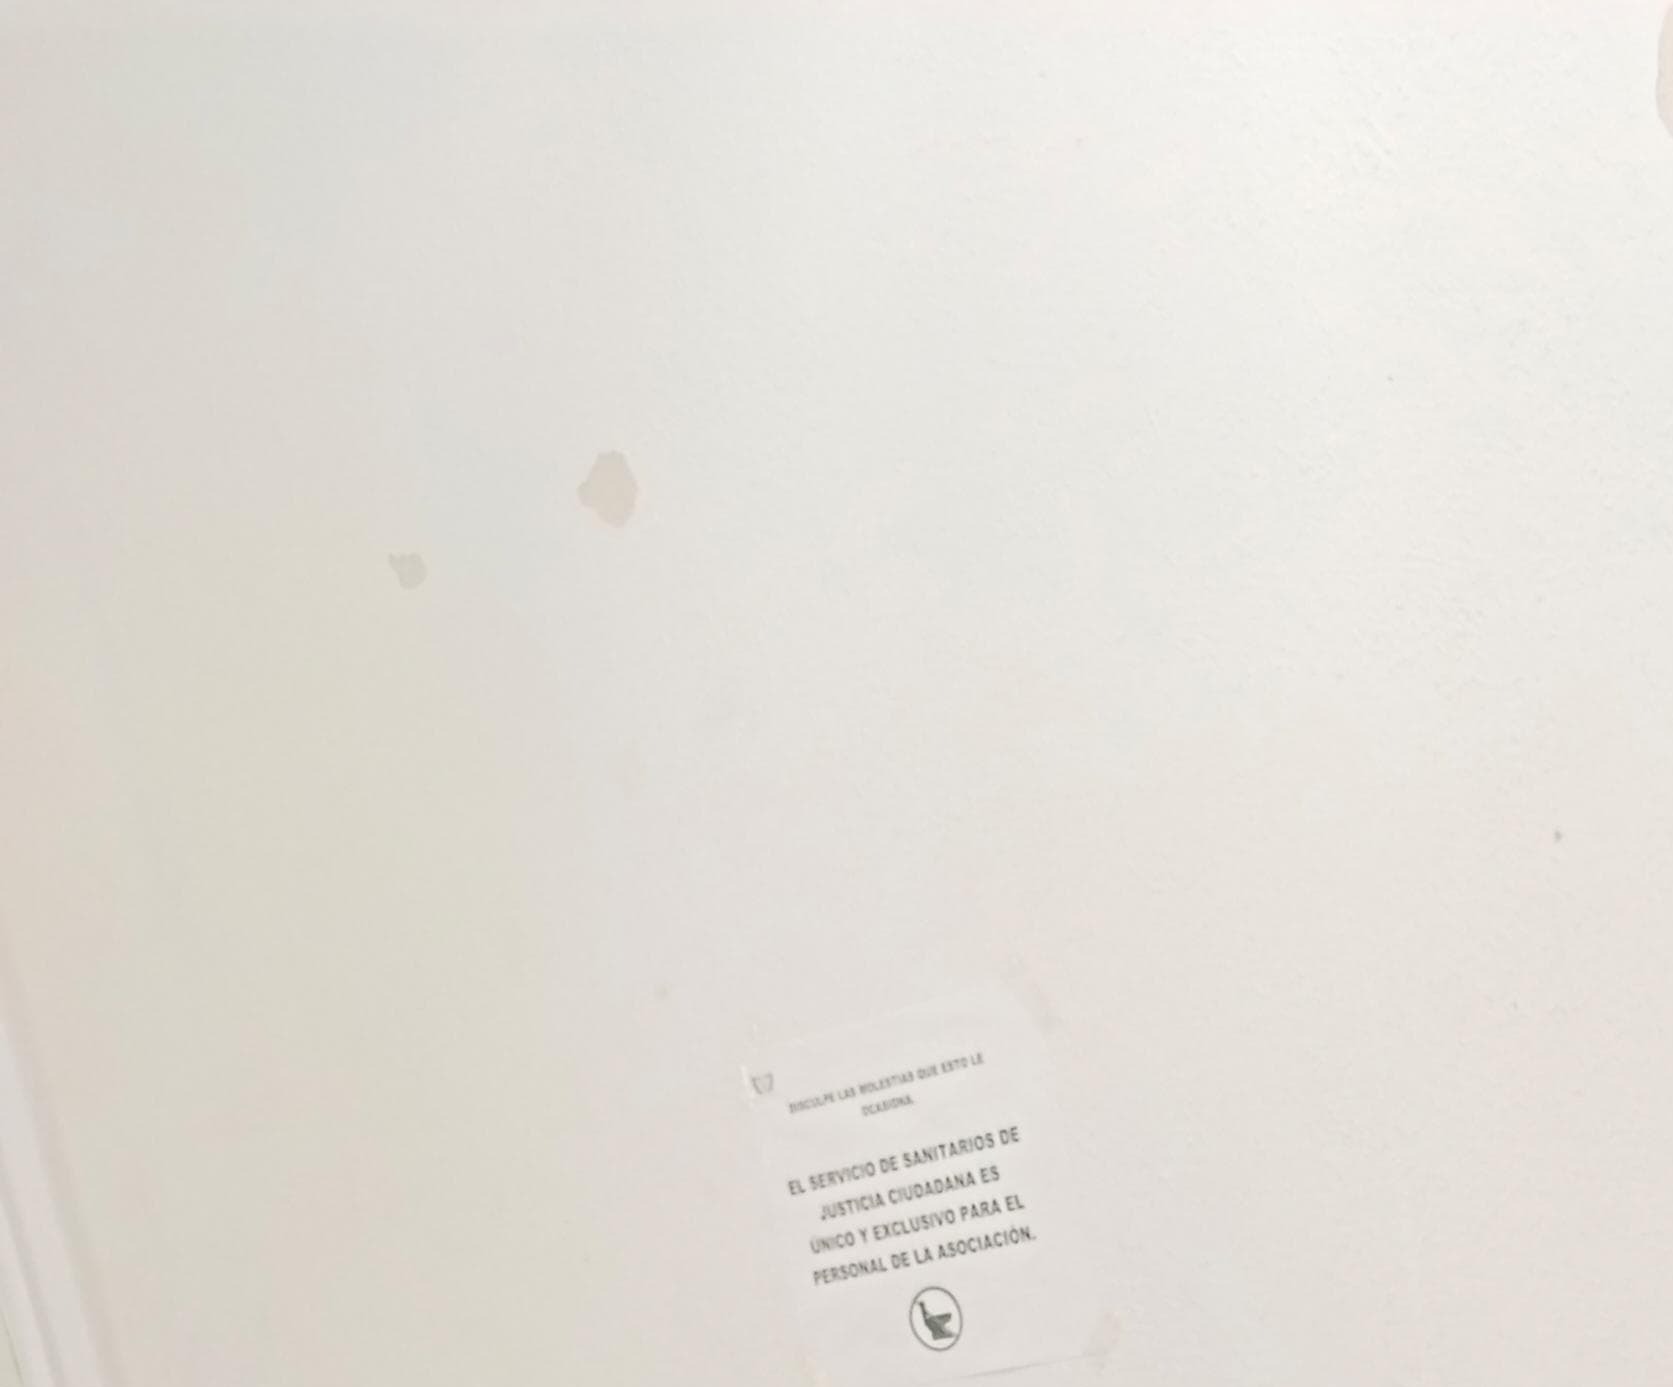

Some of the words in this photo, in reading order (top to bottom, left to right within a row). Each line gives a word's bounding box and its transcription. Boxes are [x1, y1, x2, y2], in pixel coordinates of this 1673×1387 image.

[788, 1091, 835, 1113] DISCULPE
[837, 1085, 854, 1100] LAS
[859, 1070, 914, 1094] MOLESTIAS
[916, 1063, 938, 1079] QUE
[971, 1051, 984, 1065] LE
[788, 1177, 805, 1195] EL
[809, 1162, 876, 1190] SERVICIO
[879, 1155, 898, 1173] DE
[902, 1133, 994, 1167] SANITARIOS
[999, 1126, 1019, 1145] DE
[819, 1191, 885, 1220] JUSTICIA
[887, 1171, 975, 1205] CIUDADANA
[979, 1164, 1000, 1184] ES
[859, 1228, 868, 1243] Y
[872, 1209, 956, 1241] EXCLUSIVO
[959, 1198, 1001, 1221] PARA
[1005, 1193, 1024, 1211] EL
[813, 1256, 887, 1286] PERSONAL
[890, 1251, 910, 1269] DE
[914, 1246, 932, 1264] LA
